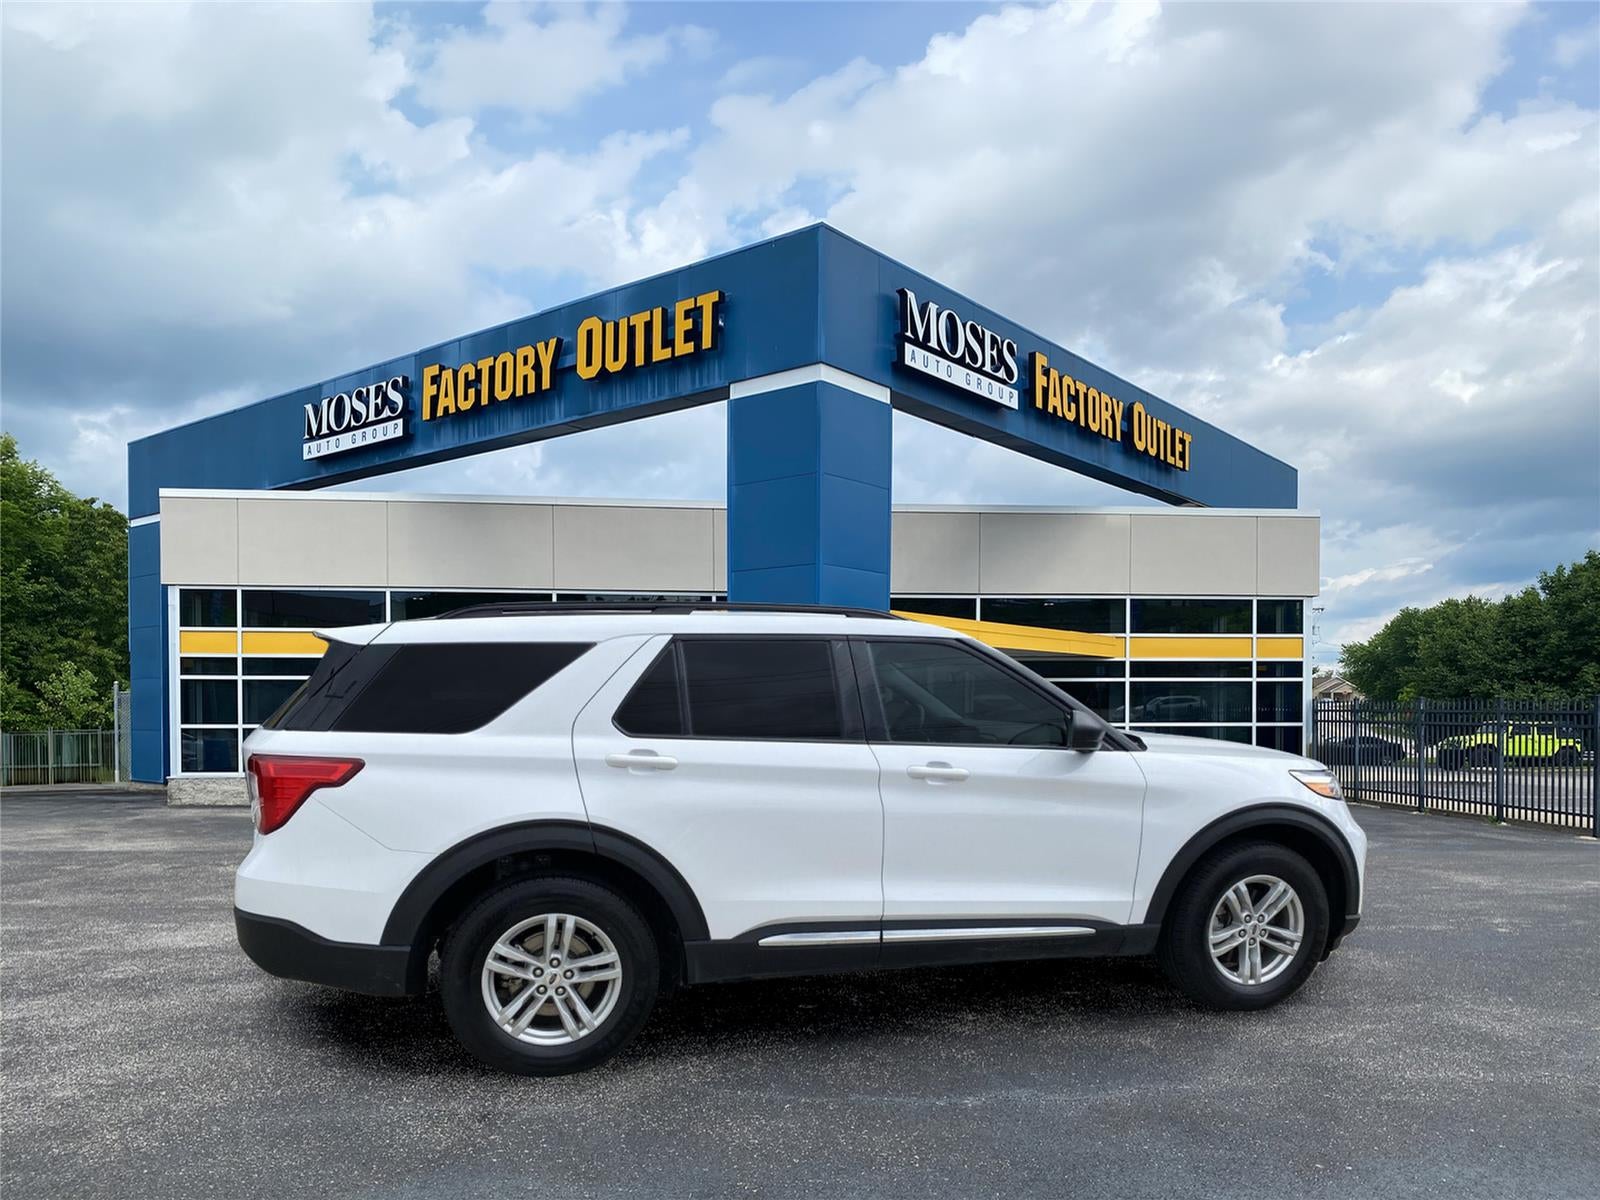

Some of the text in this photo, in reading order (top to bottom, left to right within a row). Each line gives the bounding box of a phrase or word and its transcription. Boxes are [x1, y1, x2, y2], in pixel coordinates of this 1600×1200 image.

[422, 290, 720, 421] FACTORY OUTLET
[904, 288, 1019, 384] MOSES
[910, 349, 1015, 403] AUTO GROUP
[303, 376, 404, 440] MOSES
[307, 423, 400, 456] AUTO GROUP
[1034, 351, 1192, 471] FACTORY OUTLET
